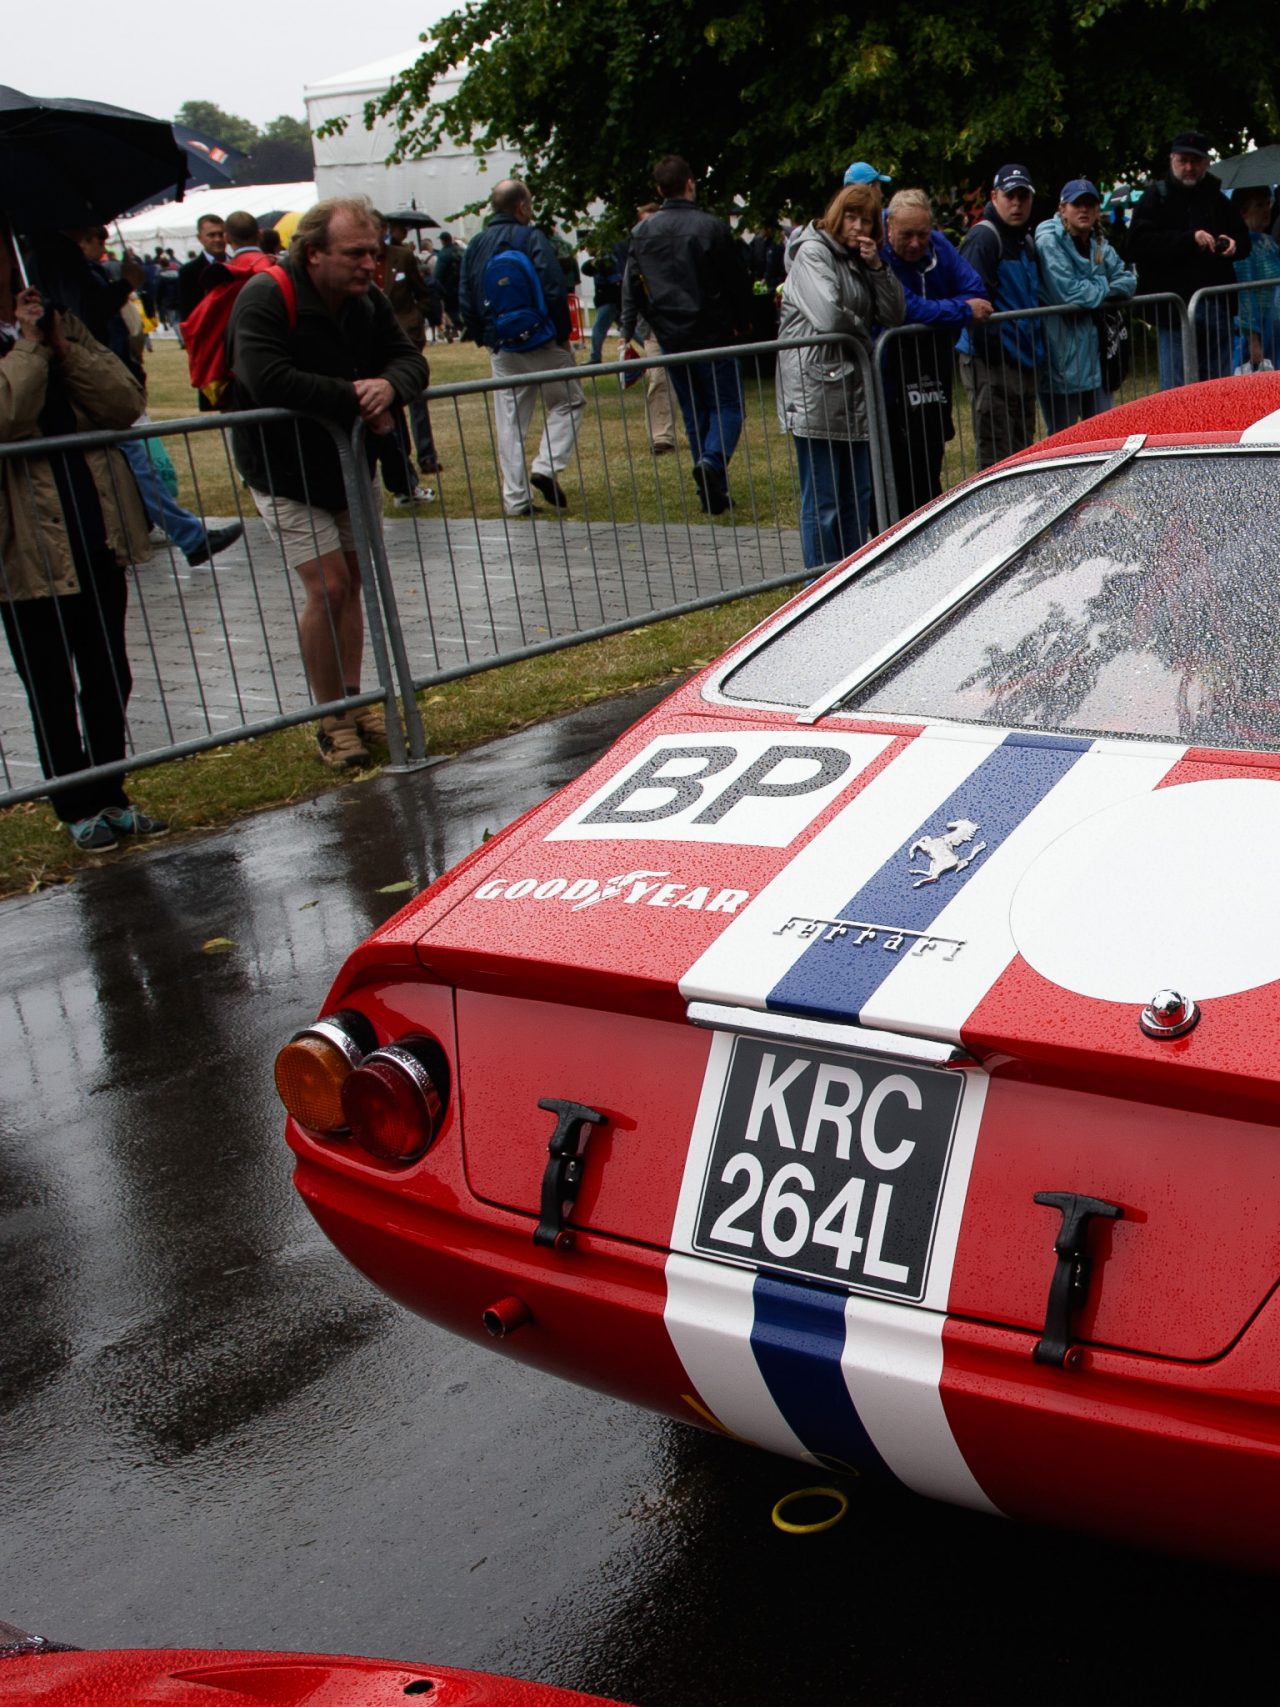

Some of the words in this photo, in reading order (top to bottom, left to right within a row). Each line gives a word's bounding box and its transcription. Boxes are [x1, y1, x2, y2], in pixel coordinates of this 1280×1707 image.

[579, 744, 852, 826] BP
[475, 870, 751, 914] GOODYEAR
[773, 917, 968, 962] Ferrari
[744, 1053, 923, 1172] KRC
[709, 1152, 911, 1284] 264L
